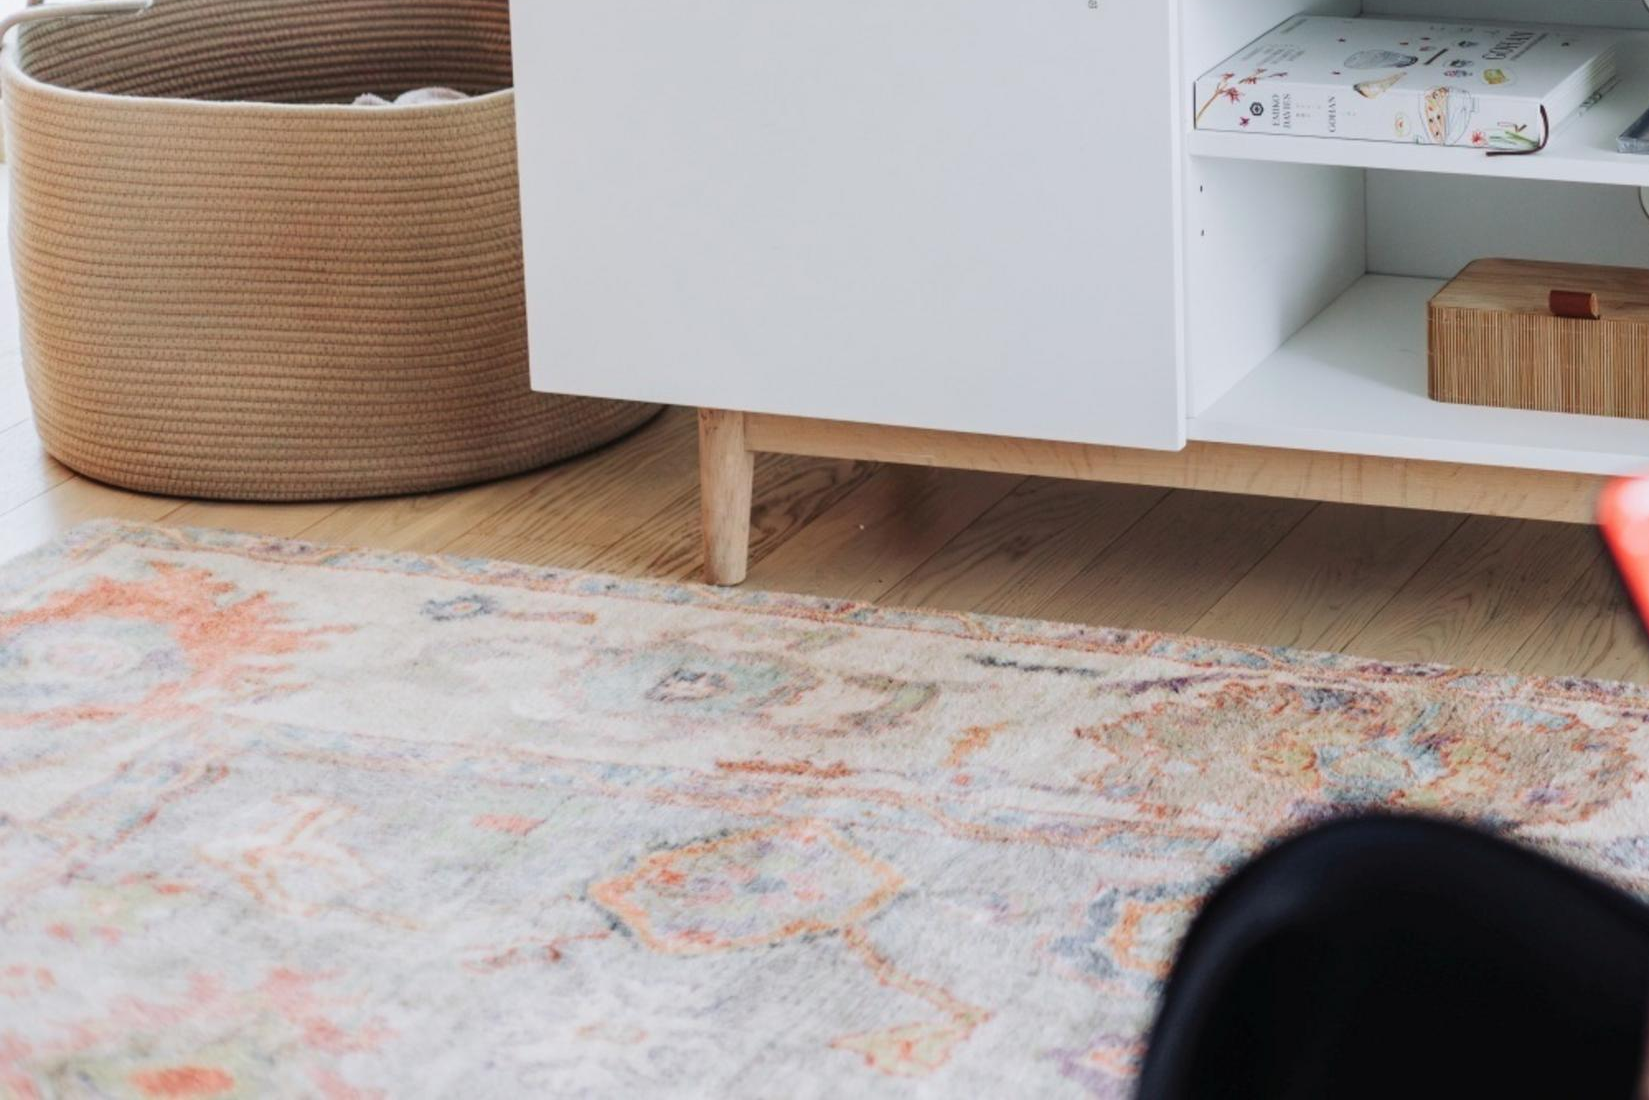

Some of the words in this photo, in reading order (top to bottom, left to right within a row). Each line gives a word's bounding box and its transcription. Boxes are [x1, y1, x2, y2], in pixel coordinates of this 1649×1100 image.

[1482, 30, 1535, 59] GOHAN
[1272, 93, 1280, 126] EMIKO
[1283, 93, 1291, 129] DAVIES
[1328, 96, 1336, 132] GOHAN
